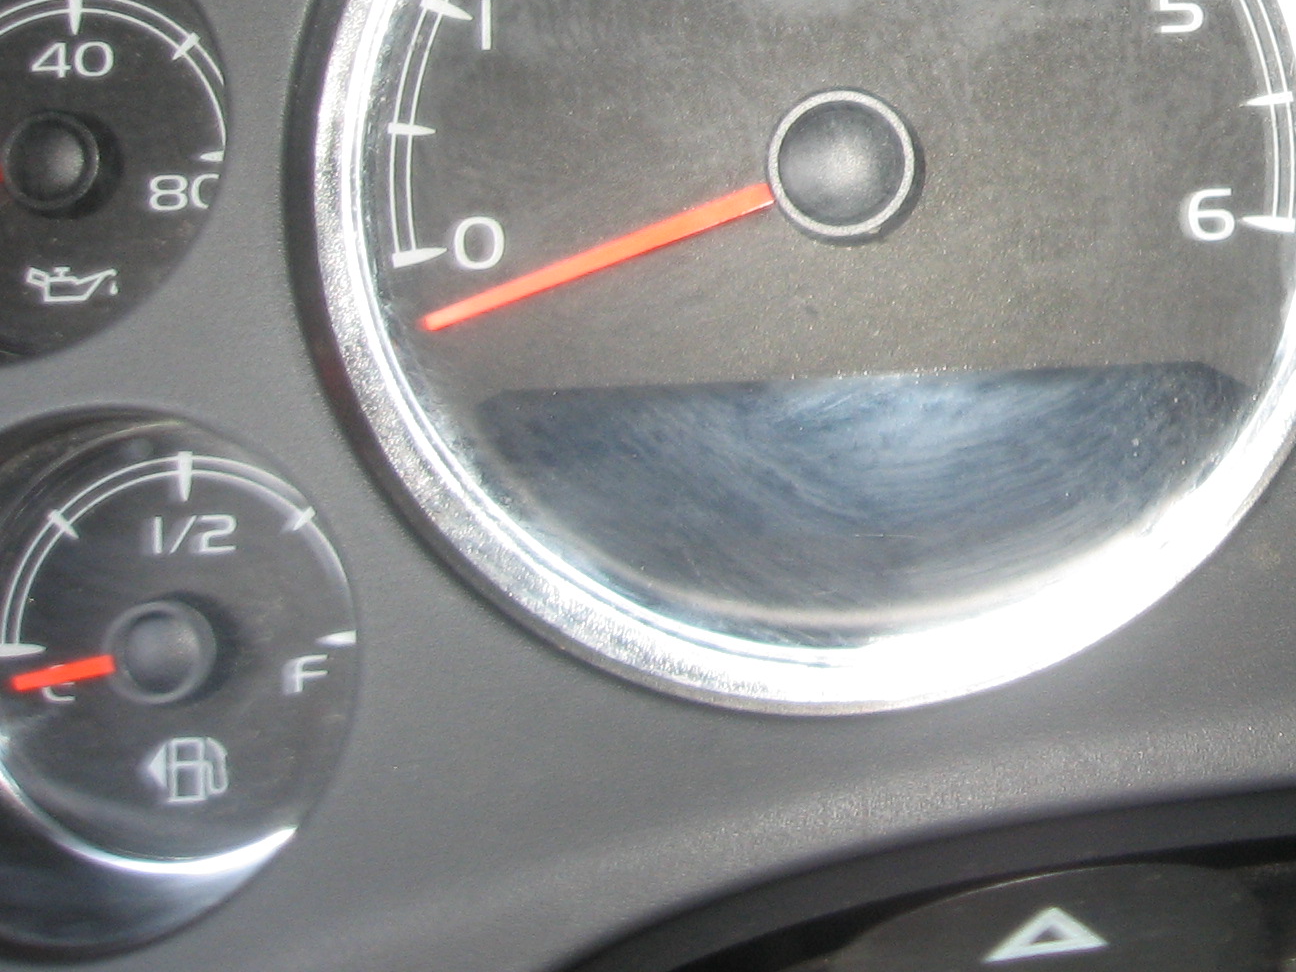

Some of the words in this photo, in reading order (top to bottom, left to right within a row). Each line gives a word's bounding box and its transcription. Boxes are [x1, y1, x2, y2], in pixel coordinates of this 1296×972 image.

[30, 40, 115, 79] 40
[1184, 188, 1235, 241] 6
[453, 217, 505, 270] 0
[148, 514, 238, 555] 1/2
[288, 653, 330, 695] F
